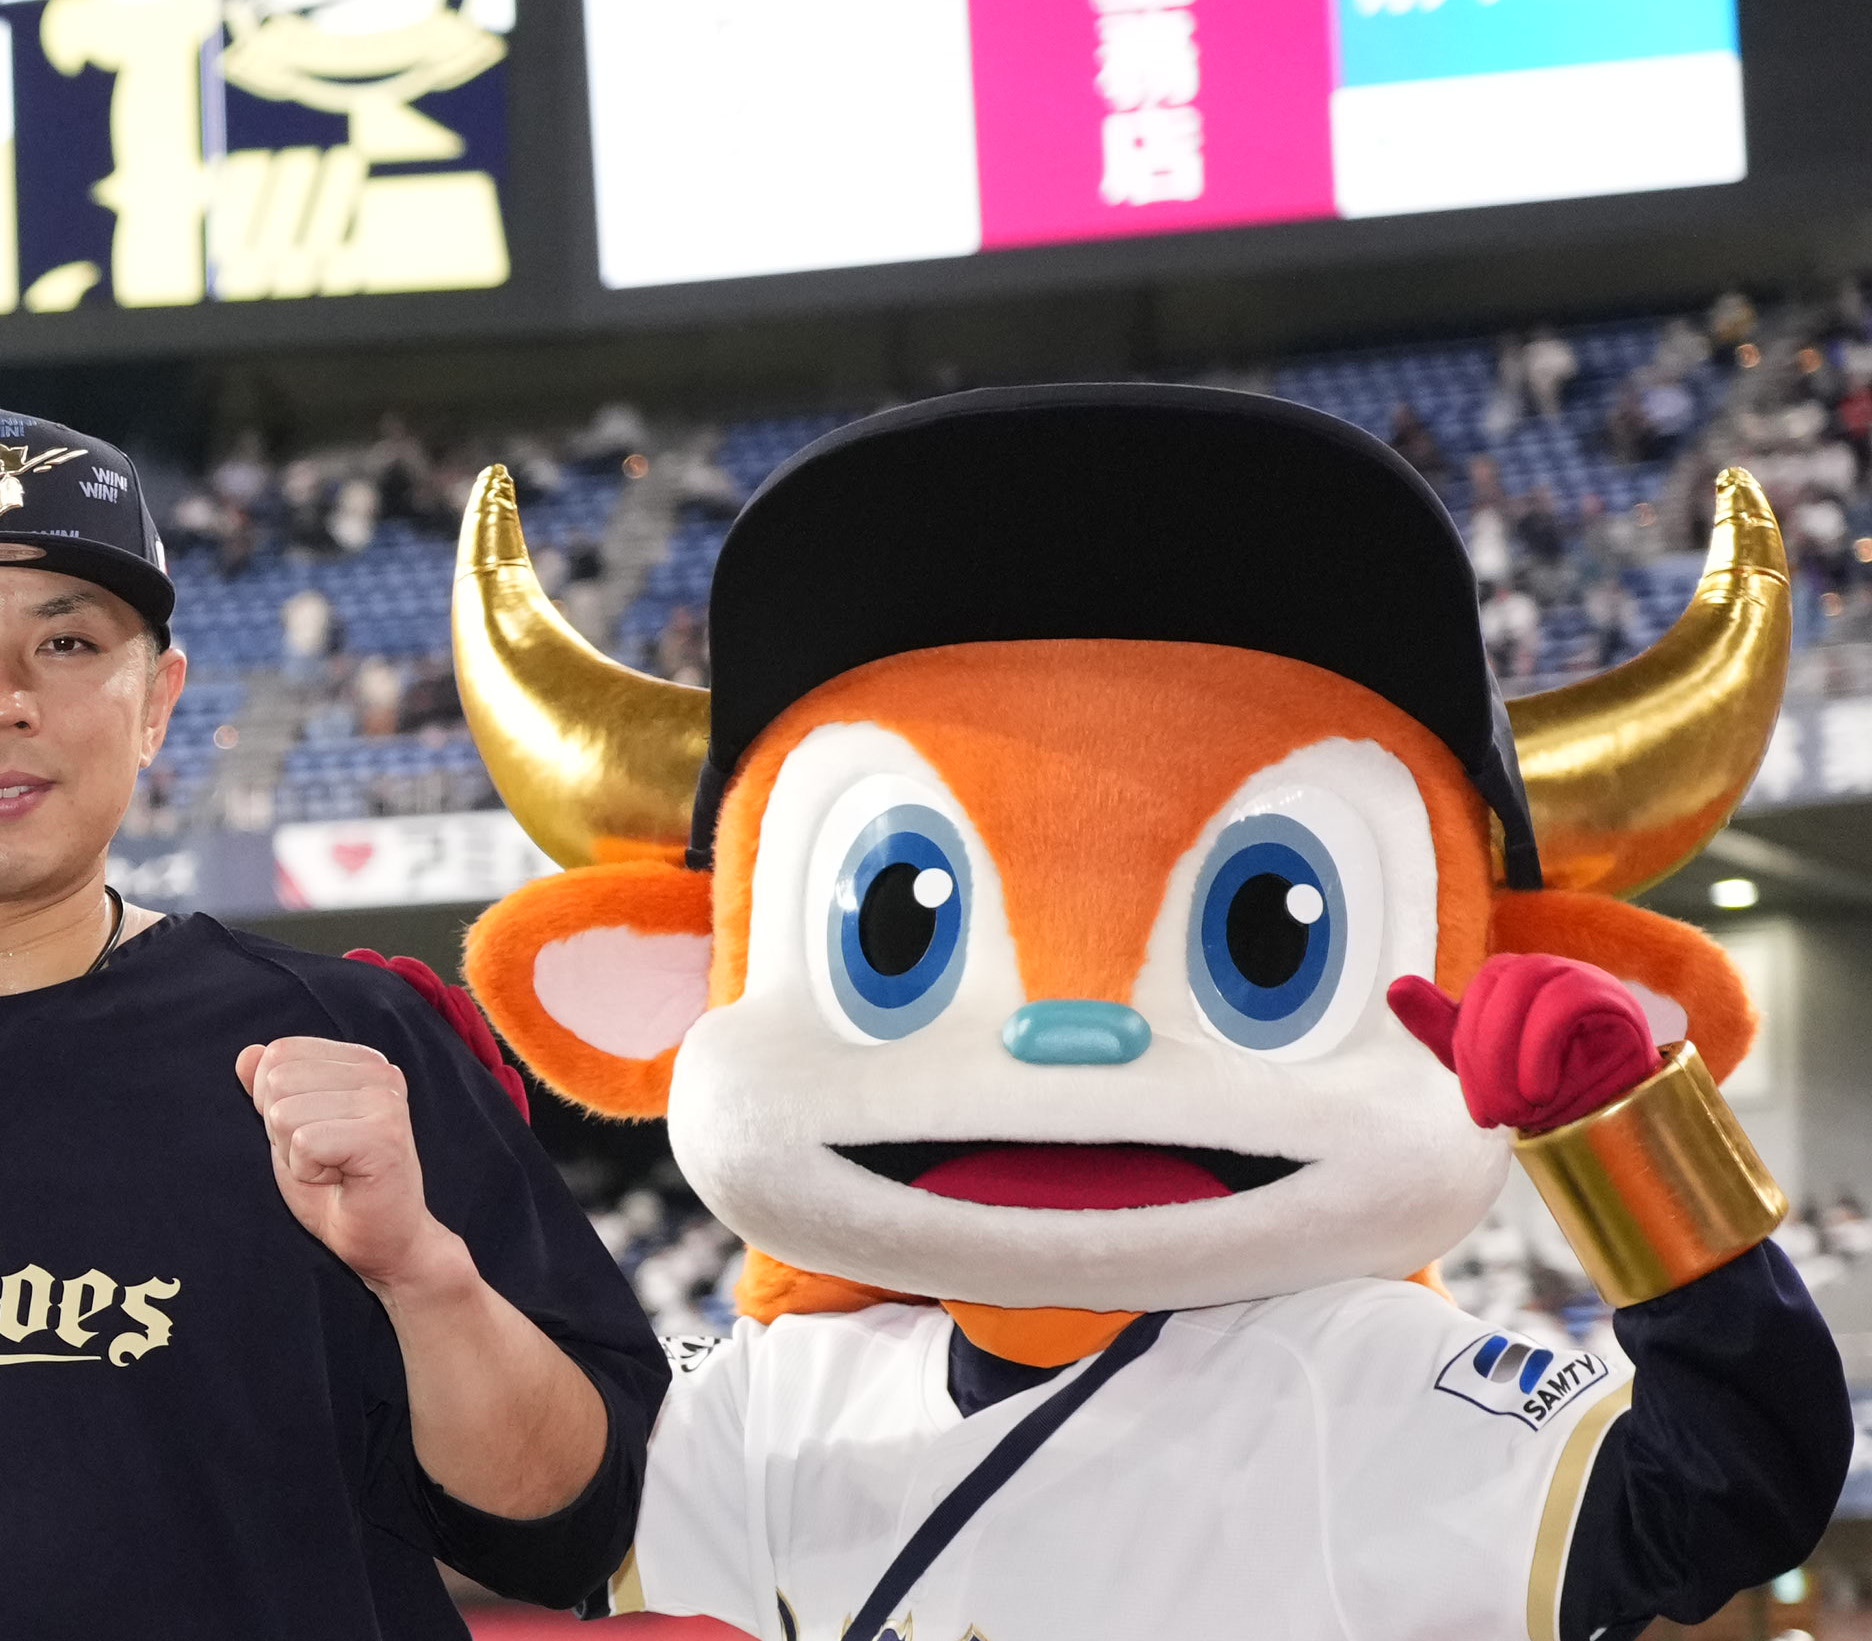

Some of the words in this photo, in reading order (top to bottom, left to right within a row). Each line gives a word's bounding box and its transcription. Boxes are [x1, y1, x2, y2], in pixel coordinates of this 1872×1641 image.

[92, 466, 128, 492] WIN!
[78, 481, 118, 504] WIN!
[1522, 1353, 1596, 1422] SAMTY
